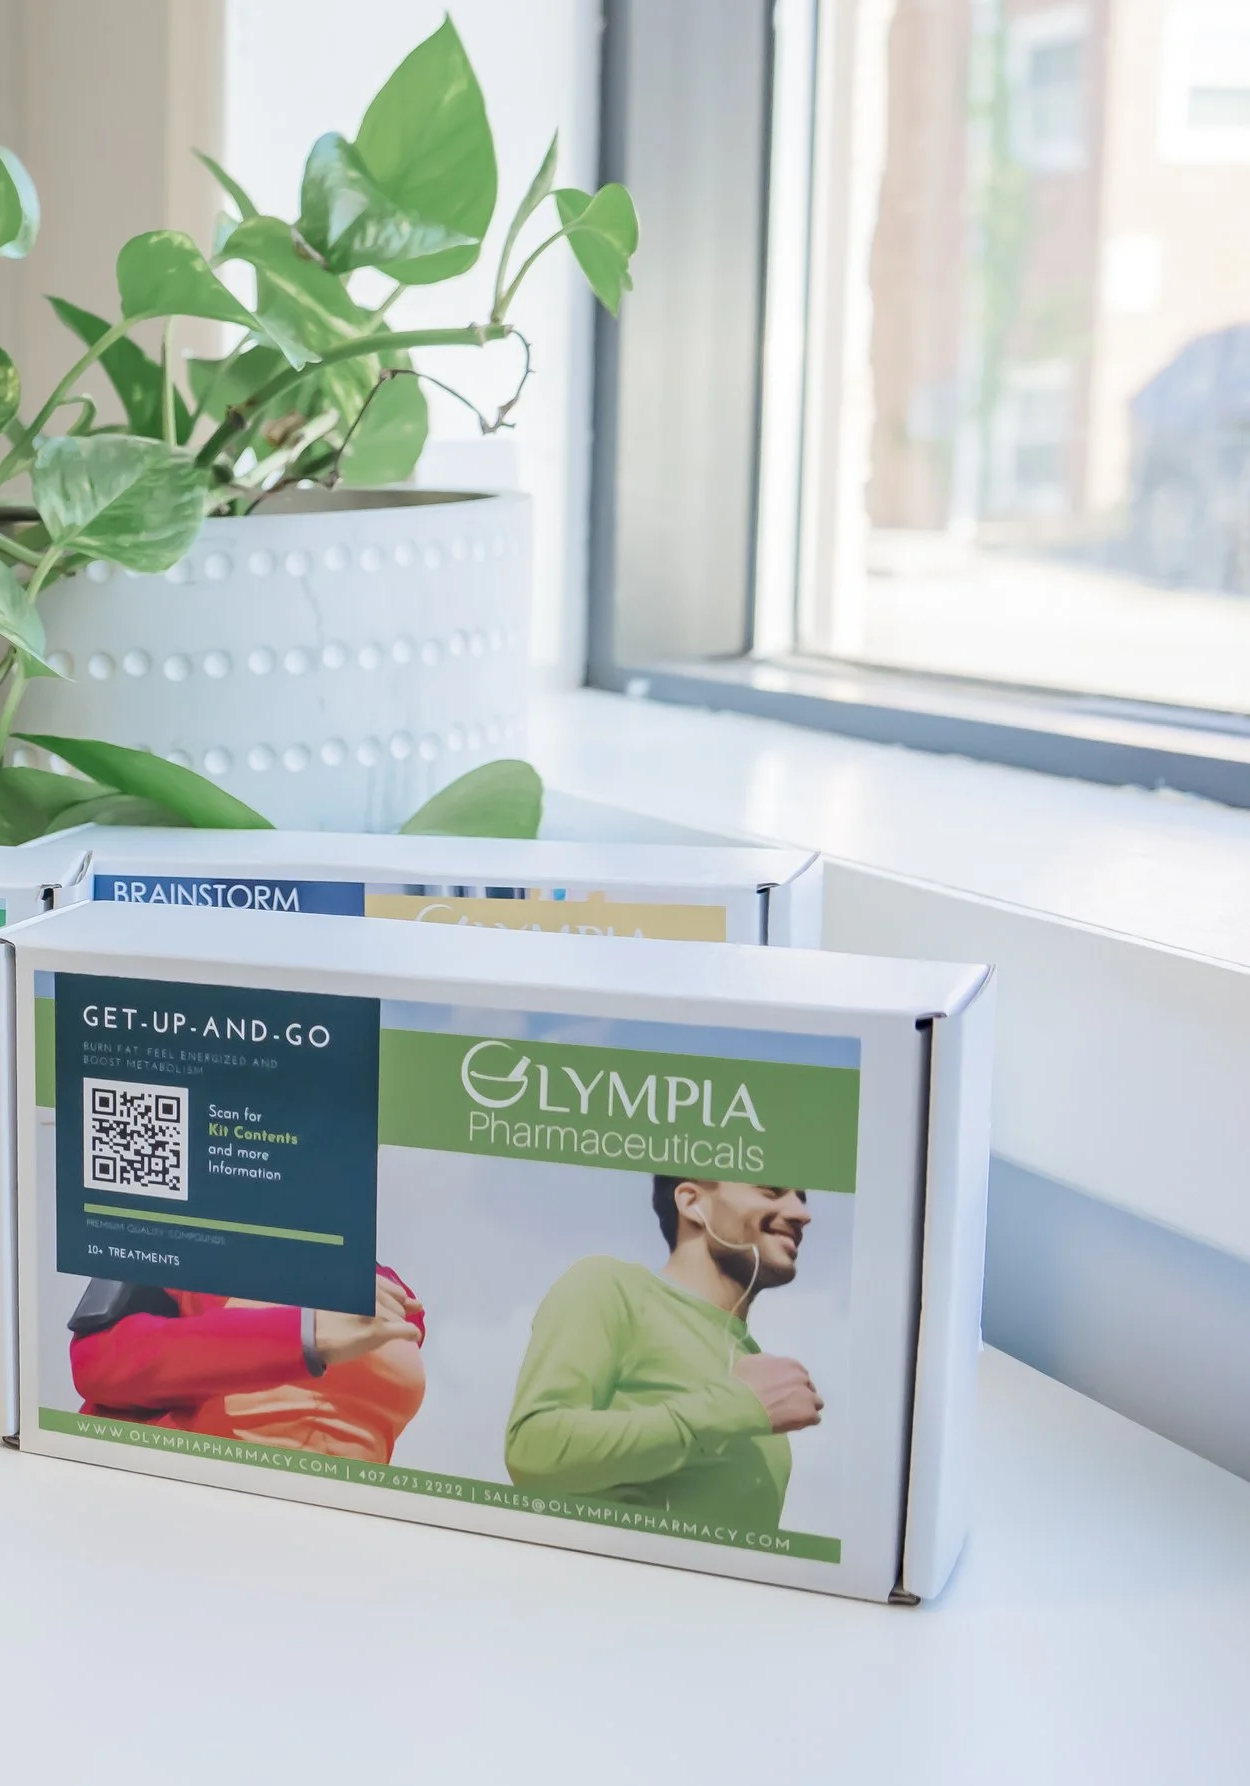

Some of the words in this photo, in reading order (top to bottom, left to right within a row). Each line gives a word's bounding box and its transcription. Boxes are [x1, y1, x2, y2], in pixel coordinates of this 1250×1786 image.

[114, 880, 300, 912] BRAINSTORM
[83, 1005, 330, 1048] GET-UP-AND-GO
[83, 1041, 112, 1053] BURN
[147, 1047, 175, 1059] FEEL
[181, 1050, 247, 1066] ENERGIZED
[253, 1058, 278, 1069] AND
[83, 1055, 121, 1067] BOOST
[209, 1104, 239, 1121] Scan
[244, 1107, 262, 1123] for
[209, 1123, 229, 1137] Kit
[234, 1125, 298, 1145] Contents
[469, 1110, 765, 1173] Pharmaceuticals
[208, 1143, 232, 1157] and
[237, 1148, 269, 1161] more
[208, 1160, 281, 1181] Information
[127, 1224, 164, 1237] QUALITY
[87, 1245, 103, 1255] 10+
[108, 1246, 180, 1266] TREATMENTS
